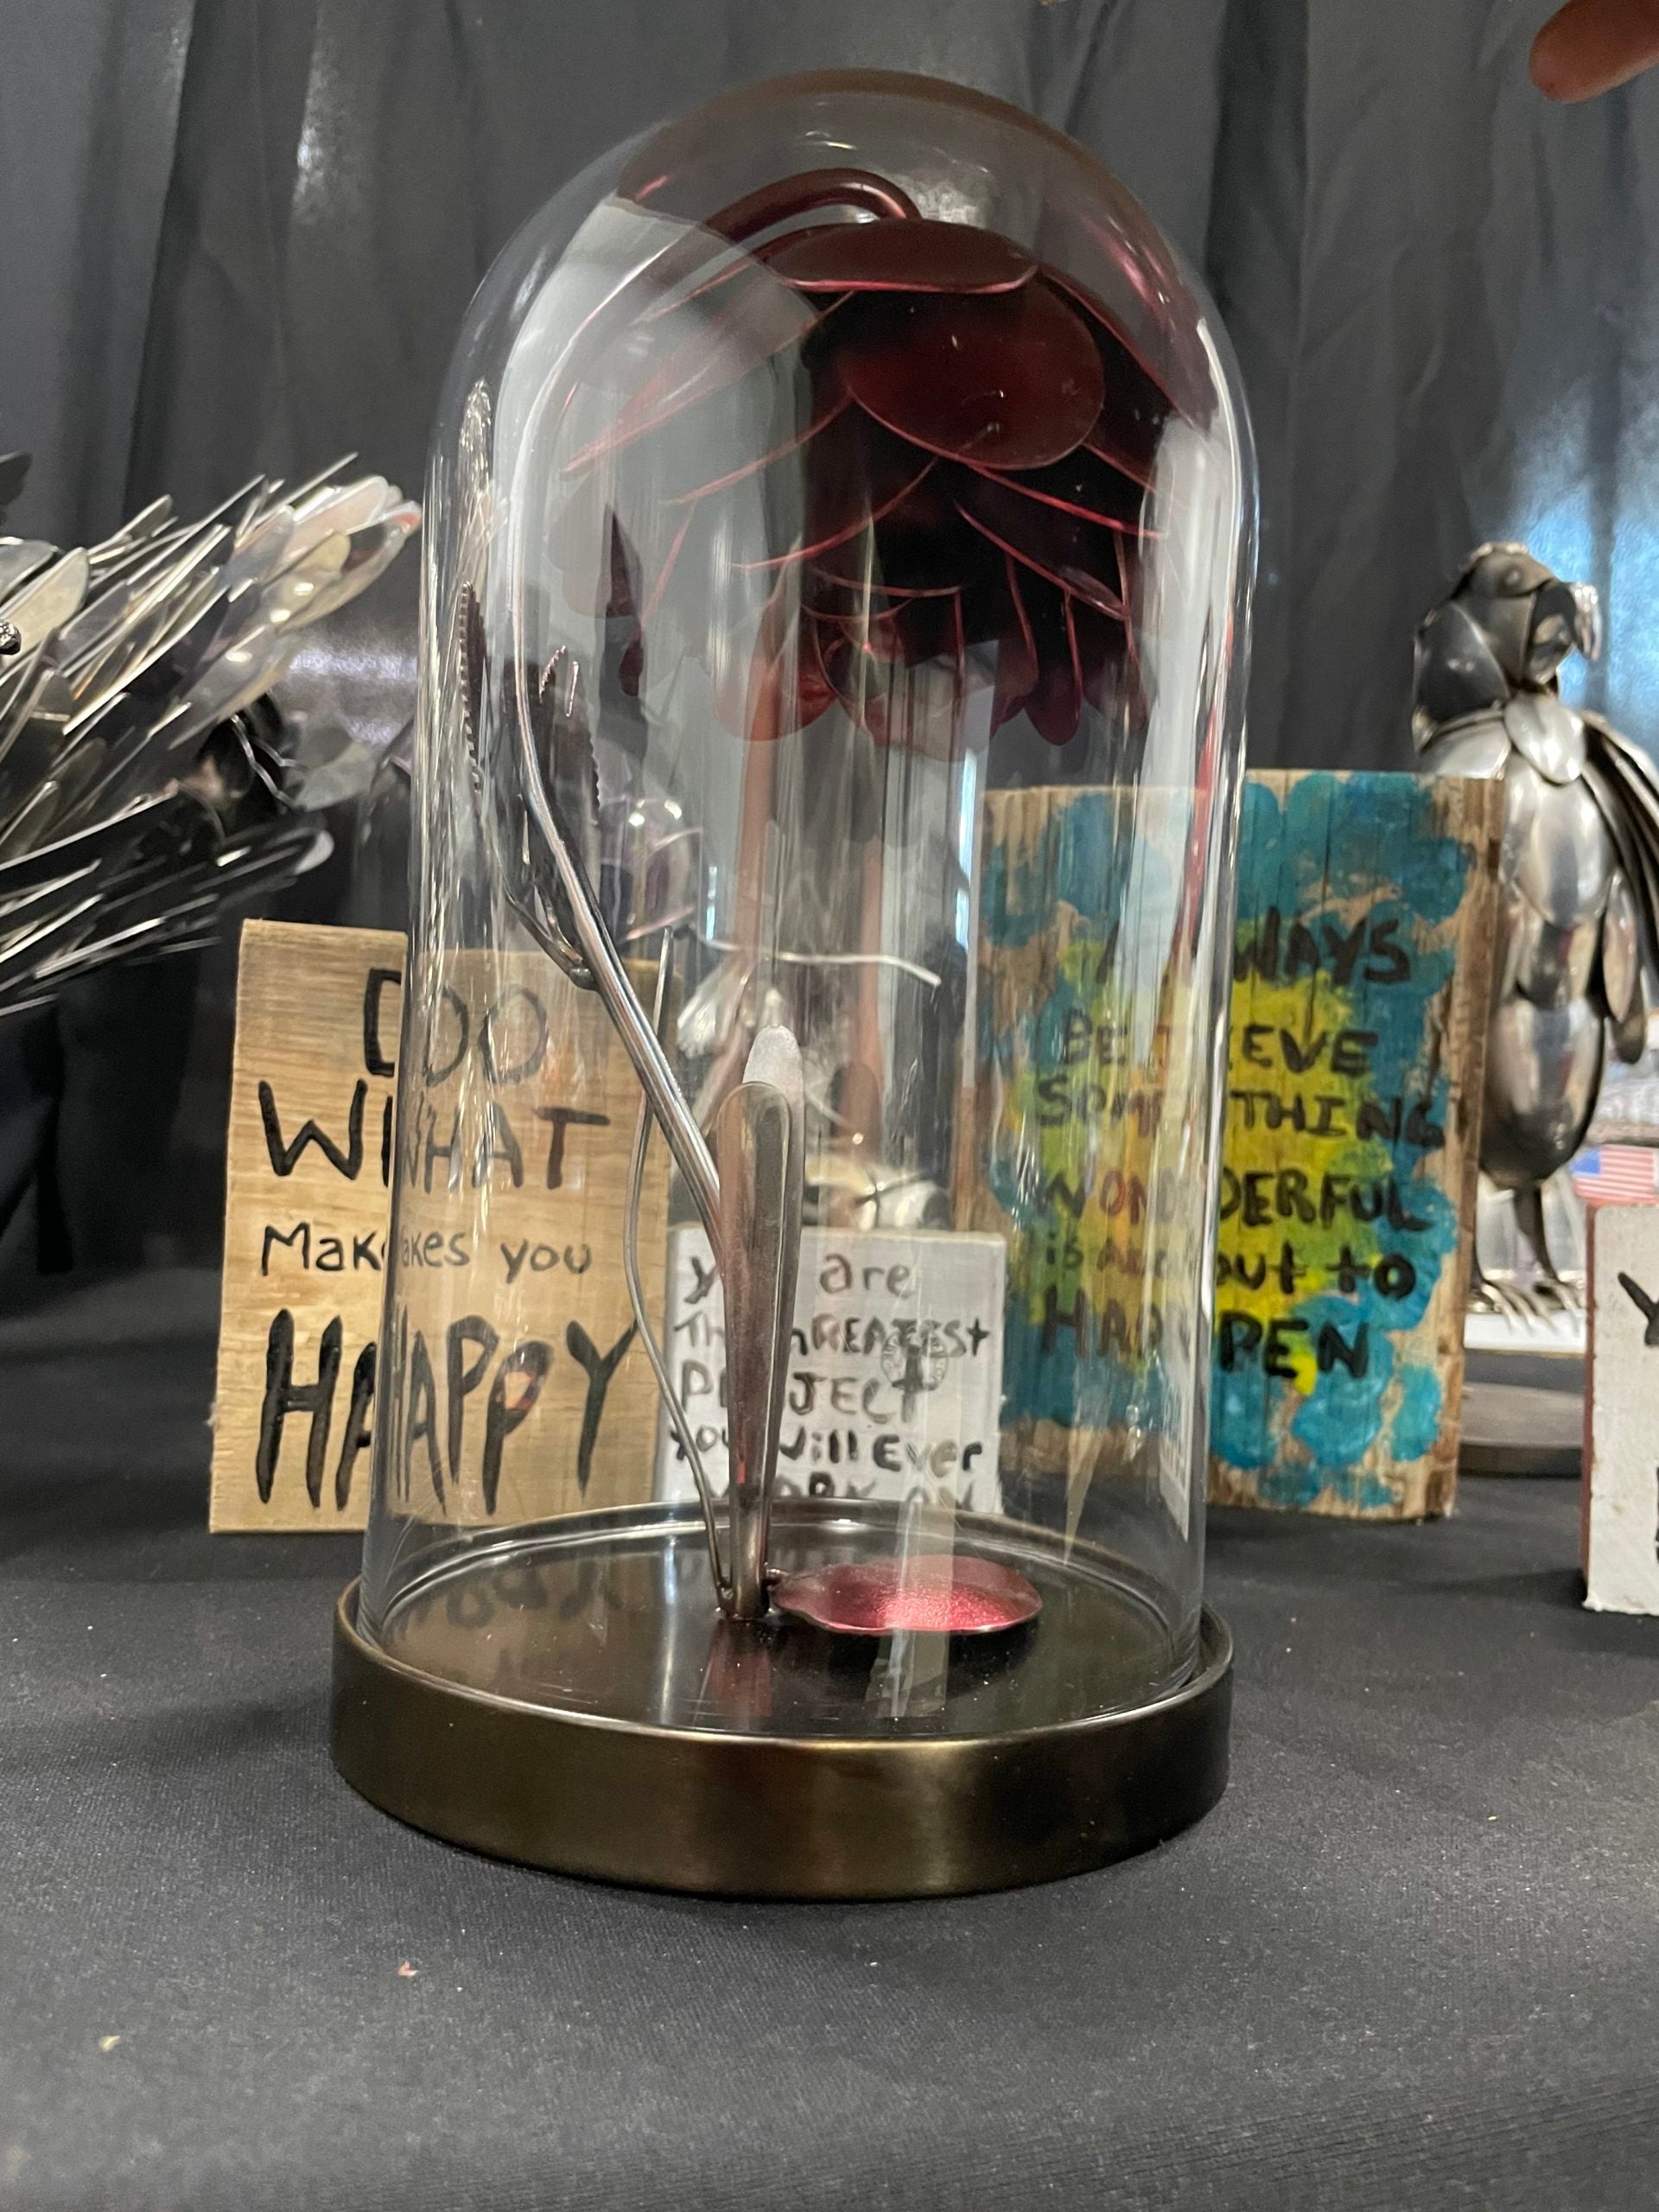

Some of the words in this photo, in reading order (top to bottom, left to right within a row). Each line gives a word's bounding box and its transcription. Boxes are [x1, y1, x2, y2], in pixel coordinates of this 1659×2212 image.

[365, 969, 548, 1086] DO
[1062, 1007, 1379, 1077] BEEVE
[258, 1078, 611, 1193] WHAT
[1036, 1074, 1445, 1148] SOMTHING
[261, 1222, 470, 1276] Makes
[501, 1241, 593, 1284] you
[819, 1253, 913, 1297] are
[1326, 1245, 1416, 1300] to
[257, 1308, 640, 1516] HAPPY
